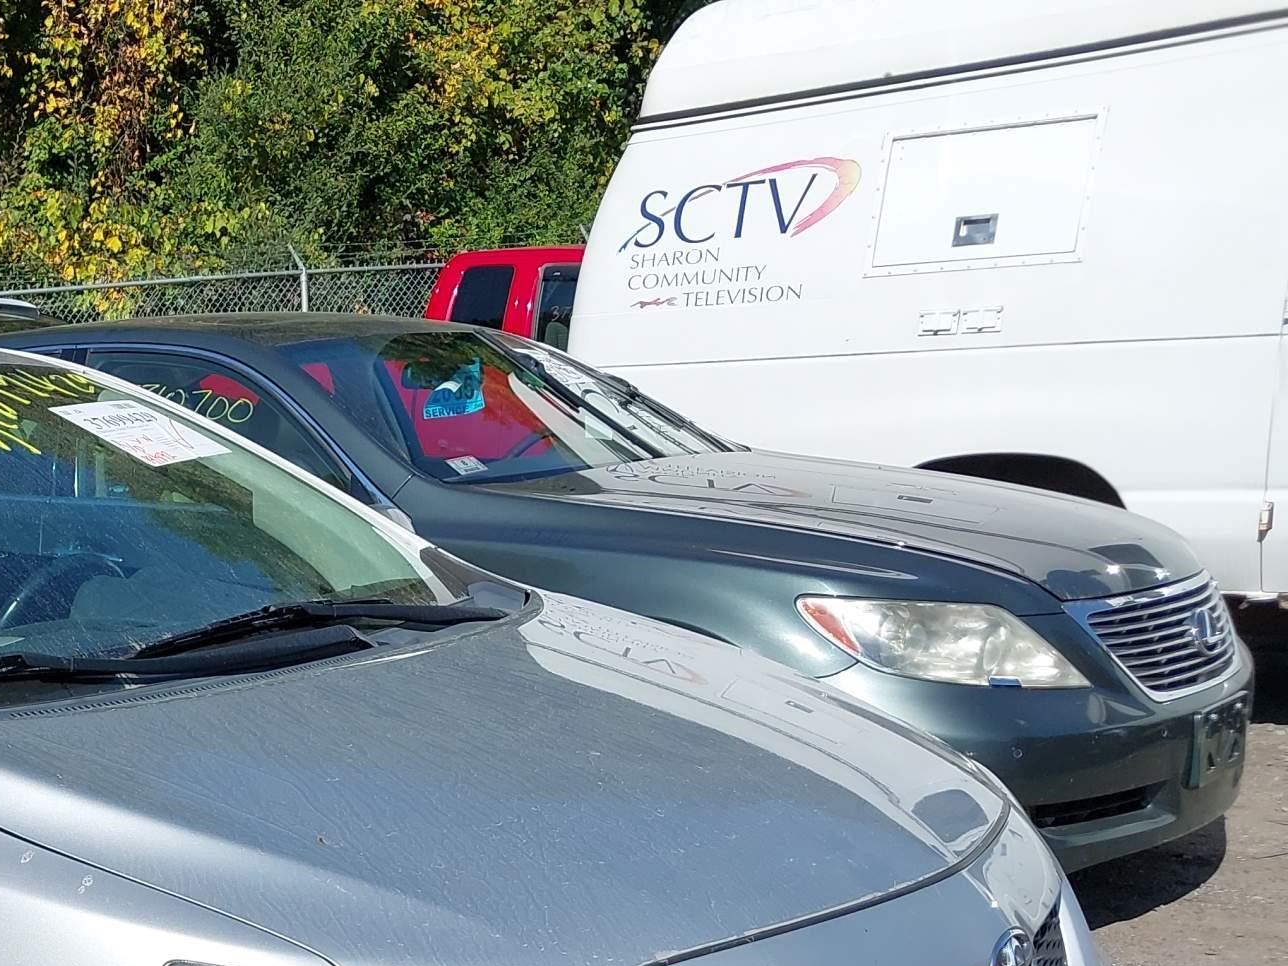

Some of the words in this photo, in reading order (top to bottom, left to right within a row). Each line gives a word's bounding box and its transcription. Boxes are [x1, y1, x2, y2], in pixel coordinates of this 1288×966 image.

[633, 173, 818, 248] SCTV
[629, 247, 721, 269] SHARON
[627, 264, 767, 291] COMMUNITY
[682, 283, 803, 307] TELEVISION
[551, 305, 572, 321] 37
[83, 411, 158, 430] 37699429
